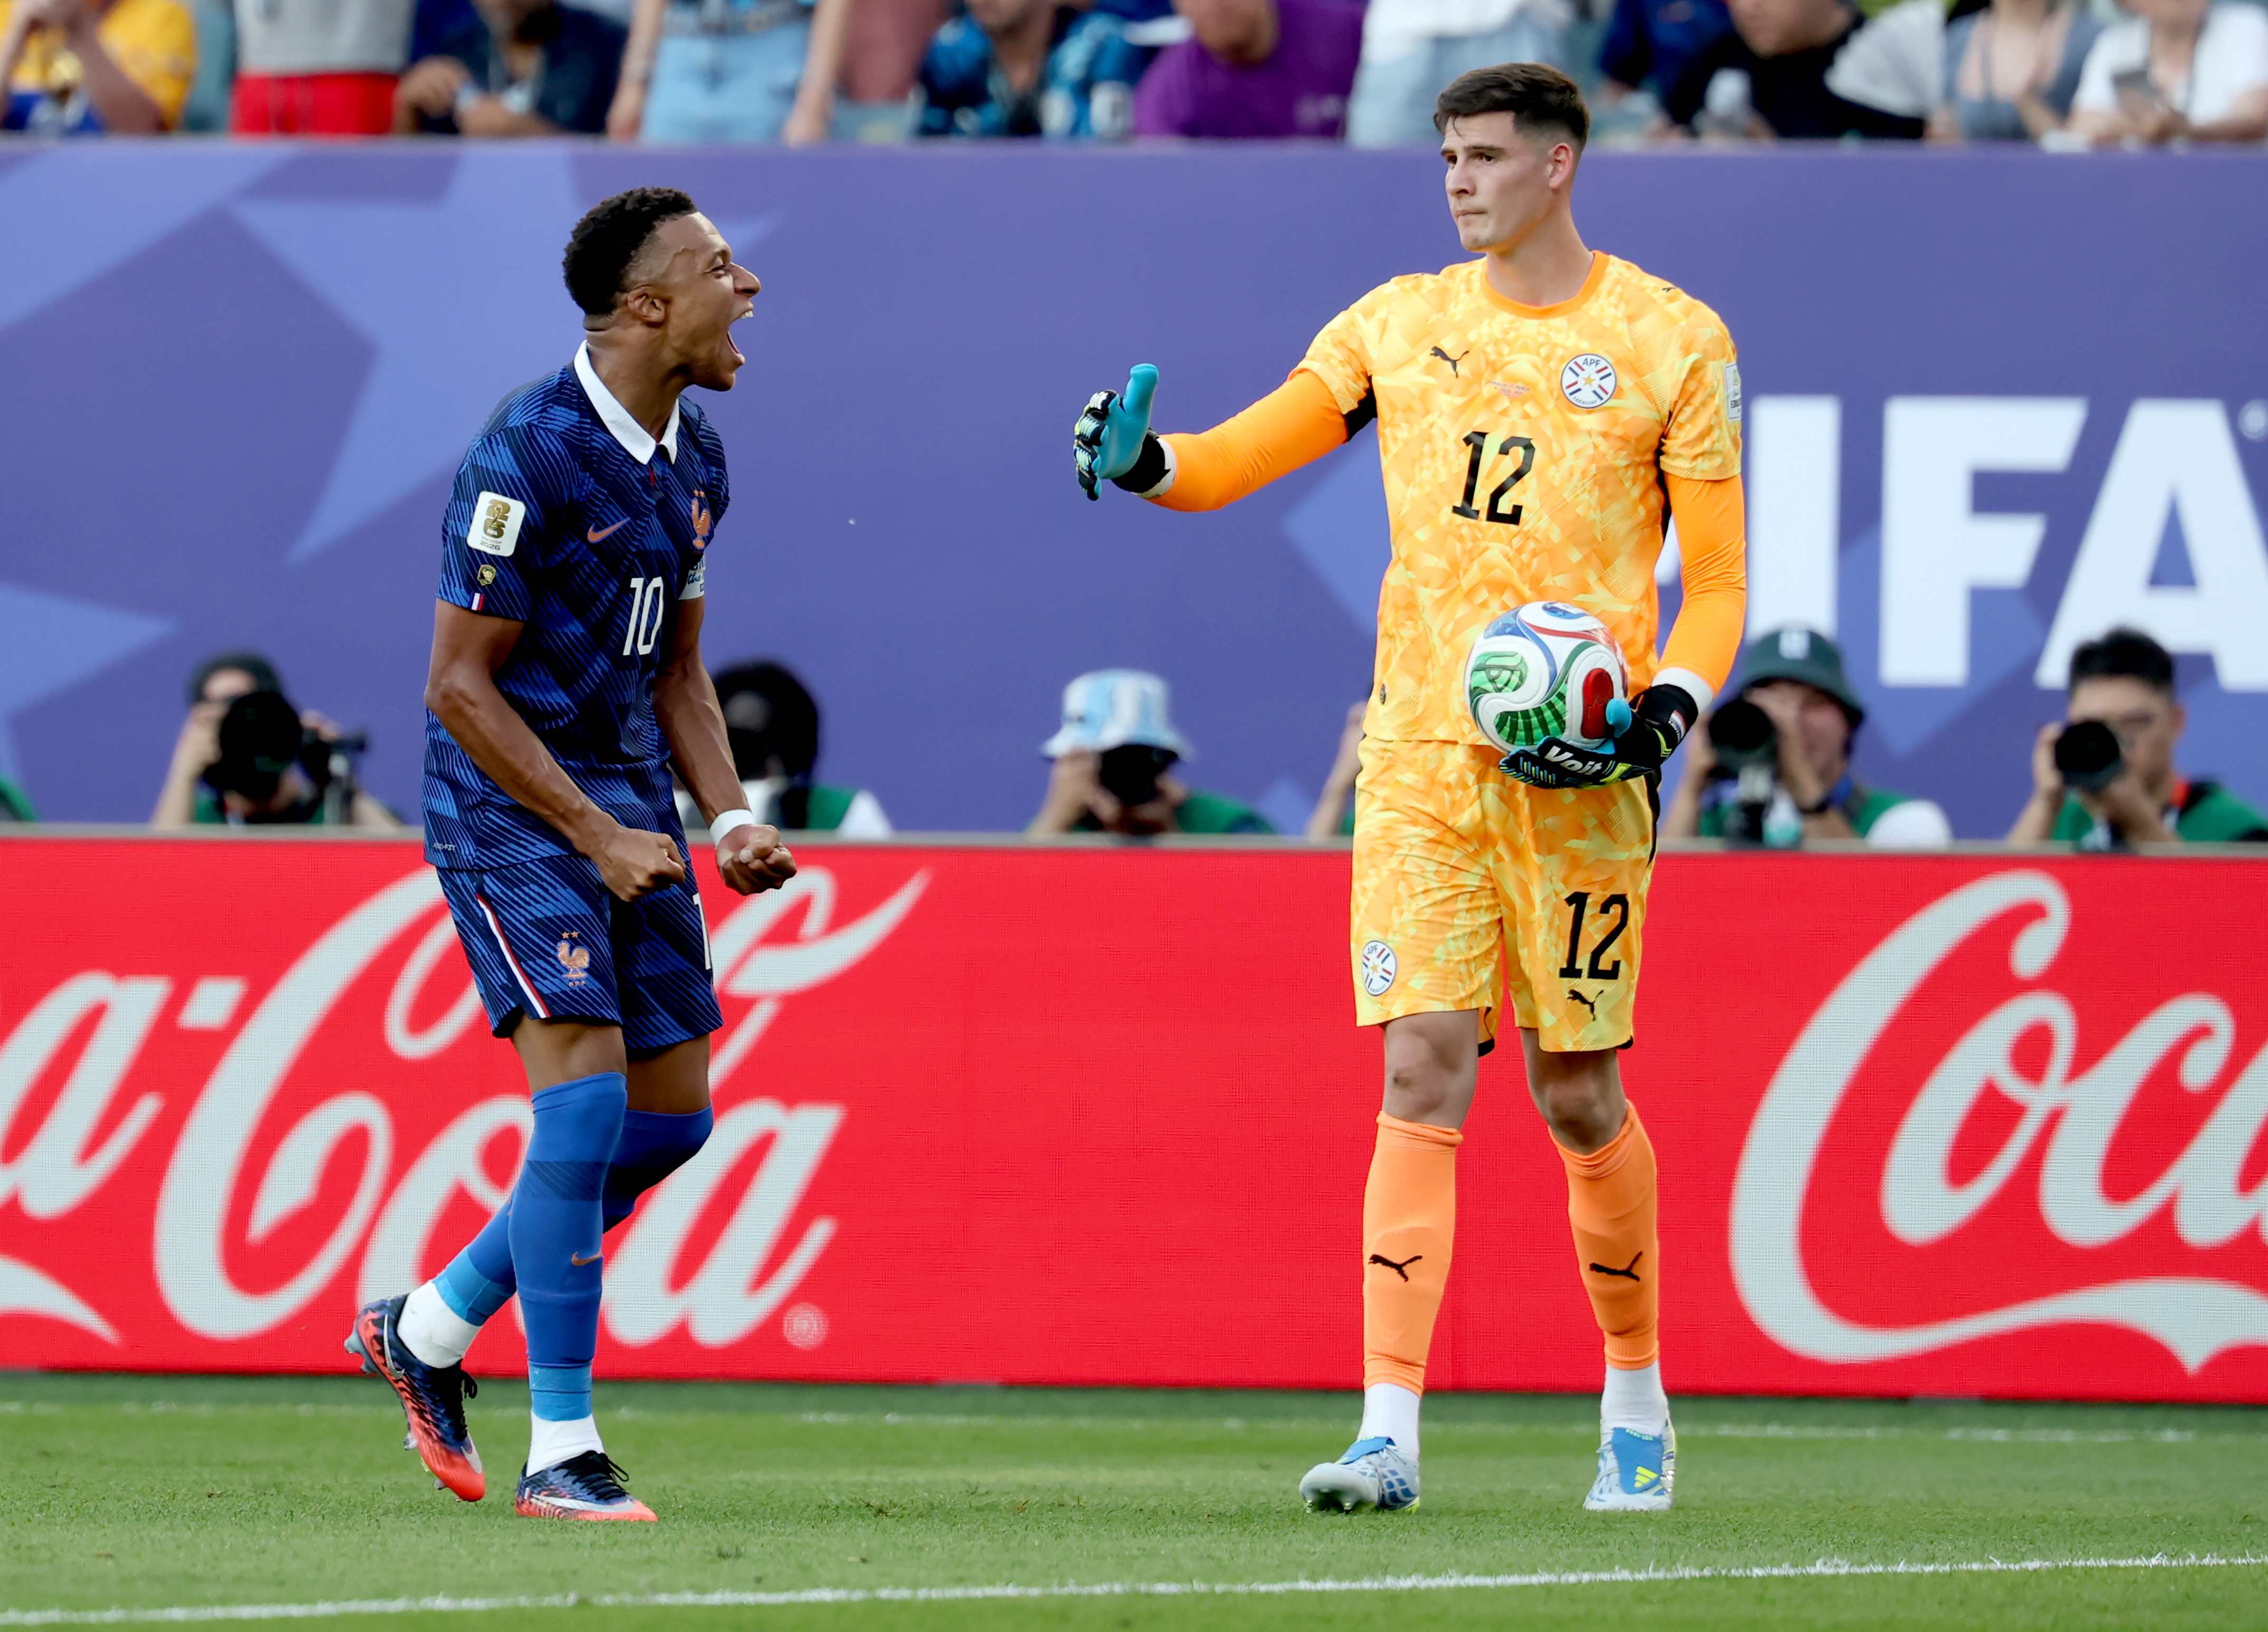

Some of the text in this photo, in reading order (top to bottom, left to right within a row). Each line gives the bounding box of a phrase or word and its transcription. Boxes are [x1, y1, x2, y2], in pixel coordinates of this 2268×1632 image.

[1582, 358, 1601, 367] APF
[1452, 431, 1535, 525] 12
[479, 540, 501, 551] 2026
[1655, 395, 2268, 692] IFA
[622, 577, 664, 656] 10
[1544, 745, 1602, 775] Voit
[1367, 944, 1378, 955] APF
[1559, 891, 1629, 980] 12
